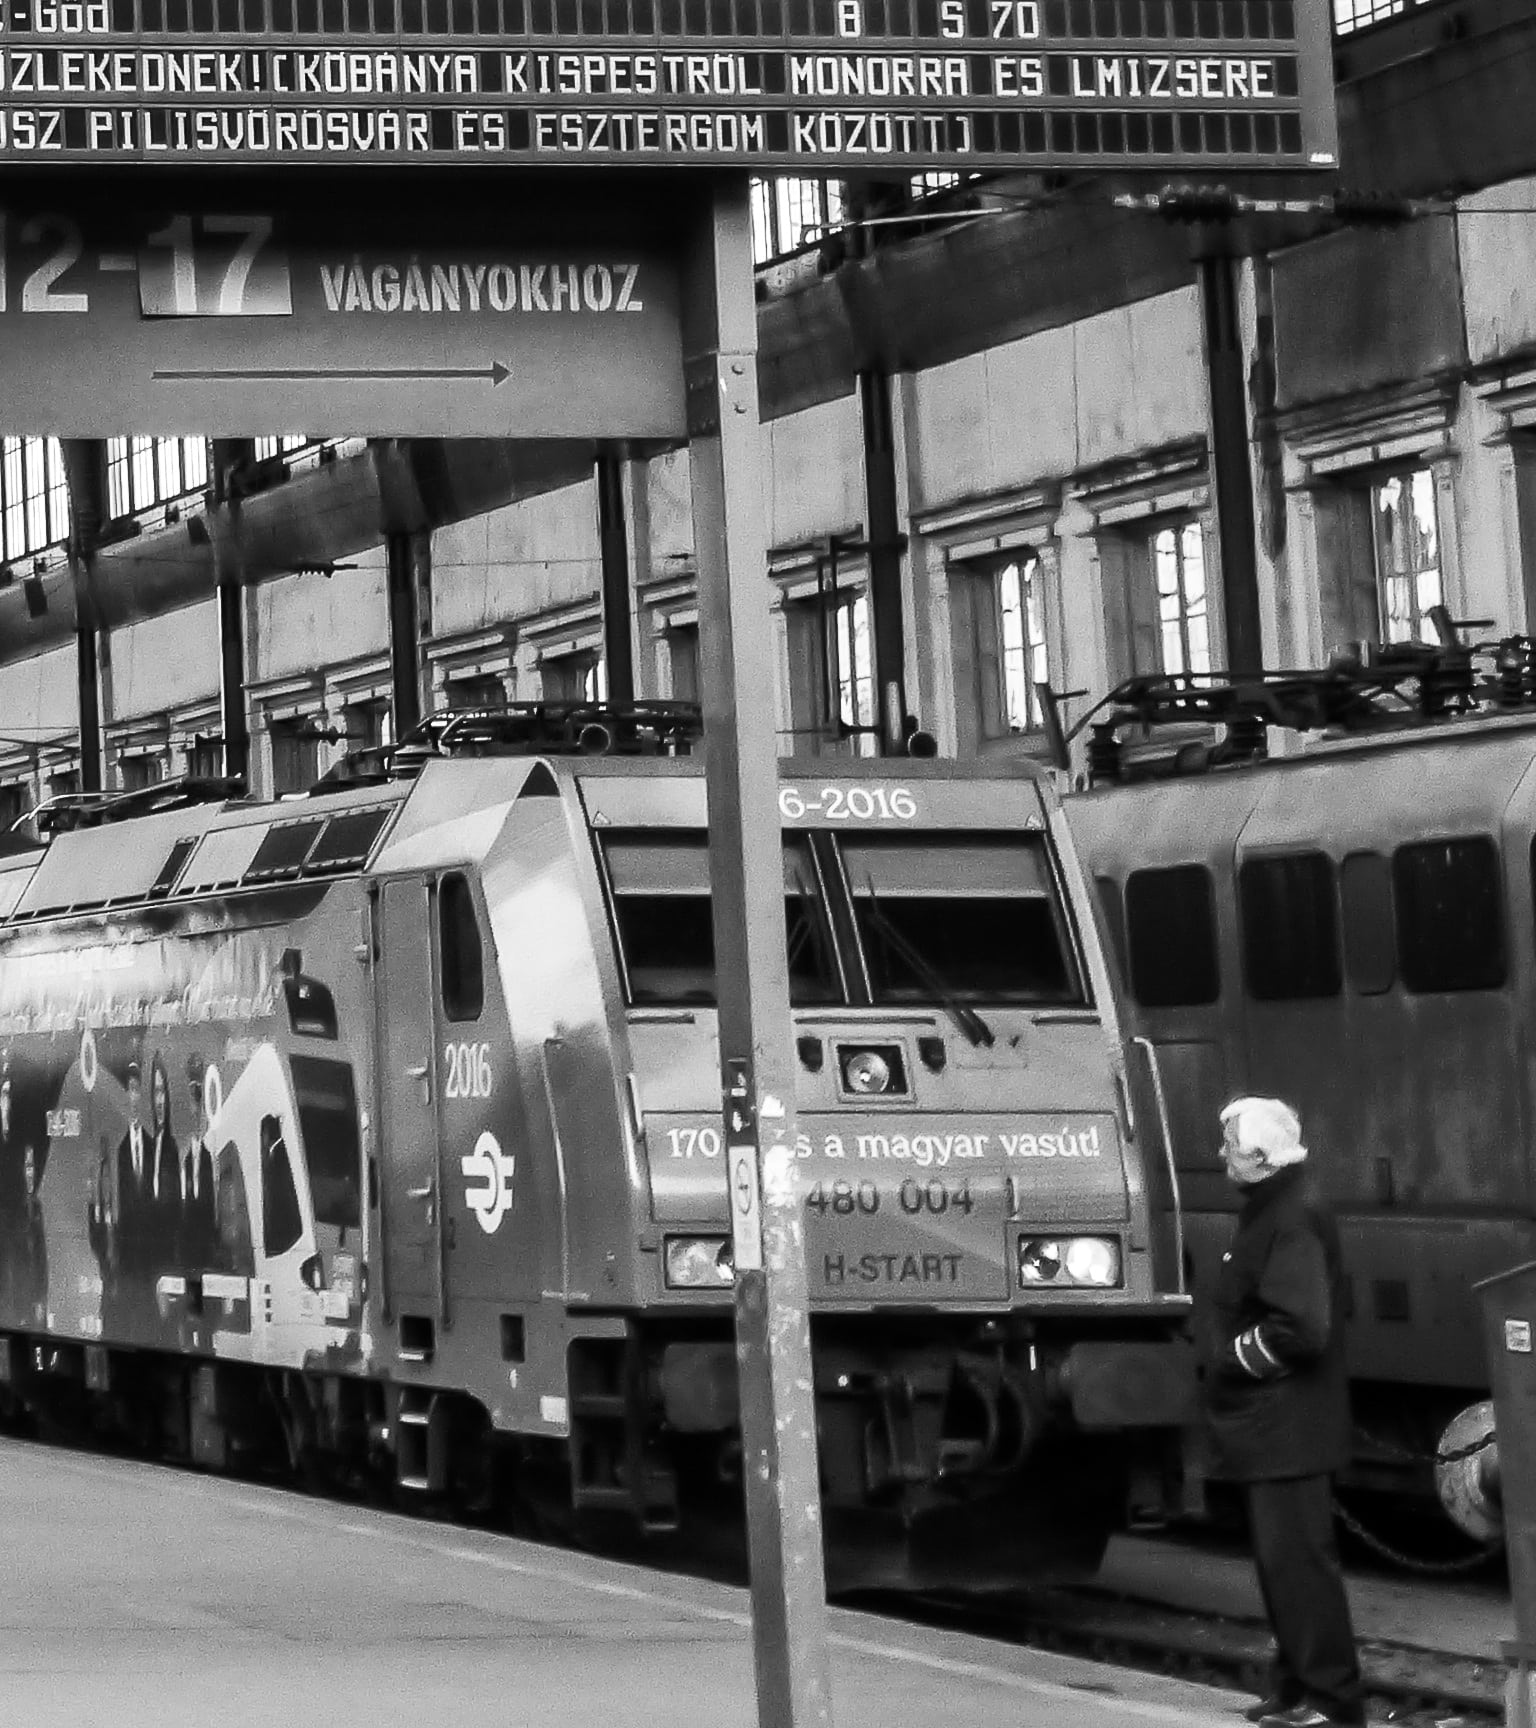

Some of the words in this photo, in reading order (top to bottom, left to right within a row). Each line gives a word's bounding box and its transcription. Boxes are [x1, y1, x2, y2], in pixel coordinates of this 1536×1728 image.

[991, 0, 1041, 36] 70
[790, 55, 967, 93] MONORRA
[994, 52, 1044, 93] ÉS
[1071, 56, 1272, 94] LMIZSERE
[456, 108, 506, 149] ÉS
[534, 112, 765, 150] ESZTERGOM
[320, 253, 644, 314] VÁGÁNYOKHOZ
[778, 788, 916, 818] 6-2016
[444, 1043, 492, 1099] 2016
[667, 1128, 721, 1158] 170
[824, 1136, 846, 1159] a
[857, 1134, 988, 1166] magyar
[998, 1129, 1101, 1158] vasút!
[805, 1181, 881, 1214] 480
[899, 1180, 975, 1214] 004
[824, 1255, 963, 1283] H-START
